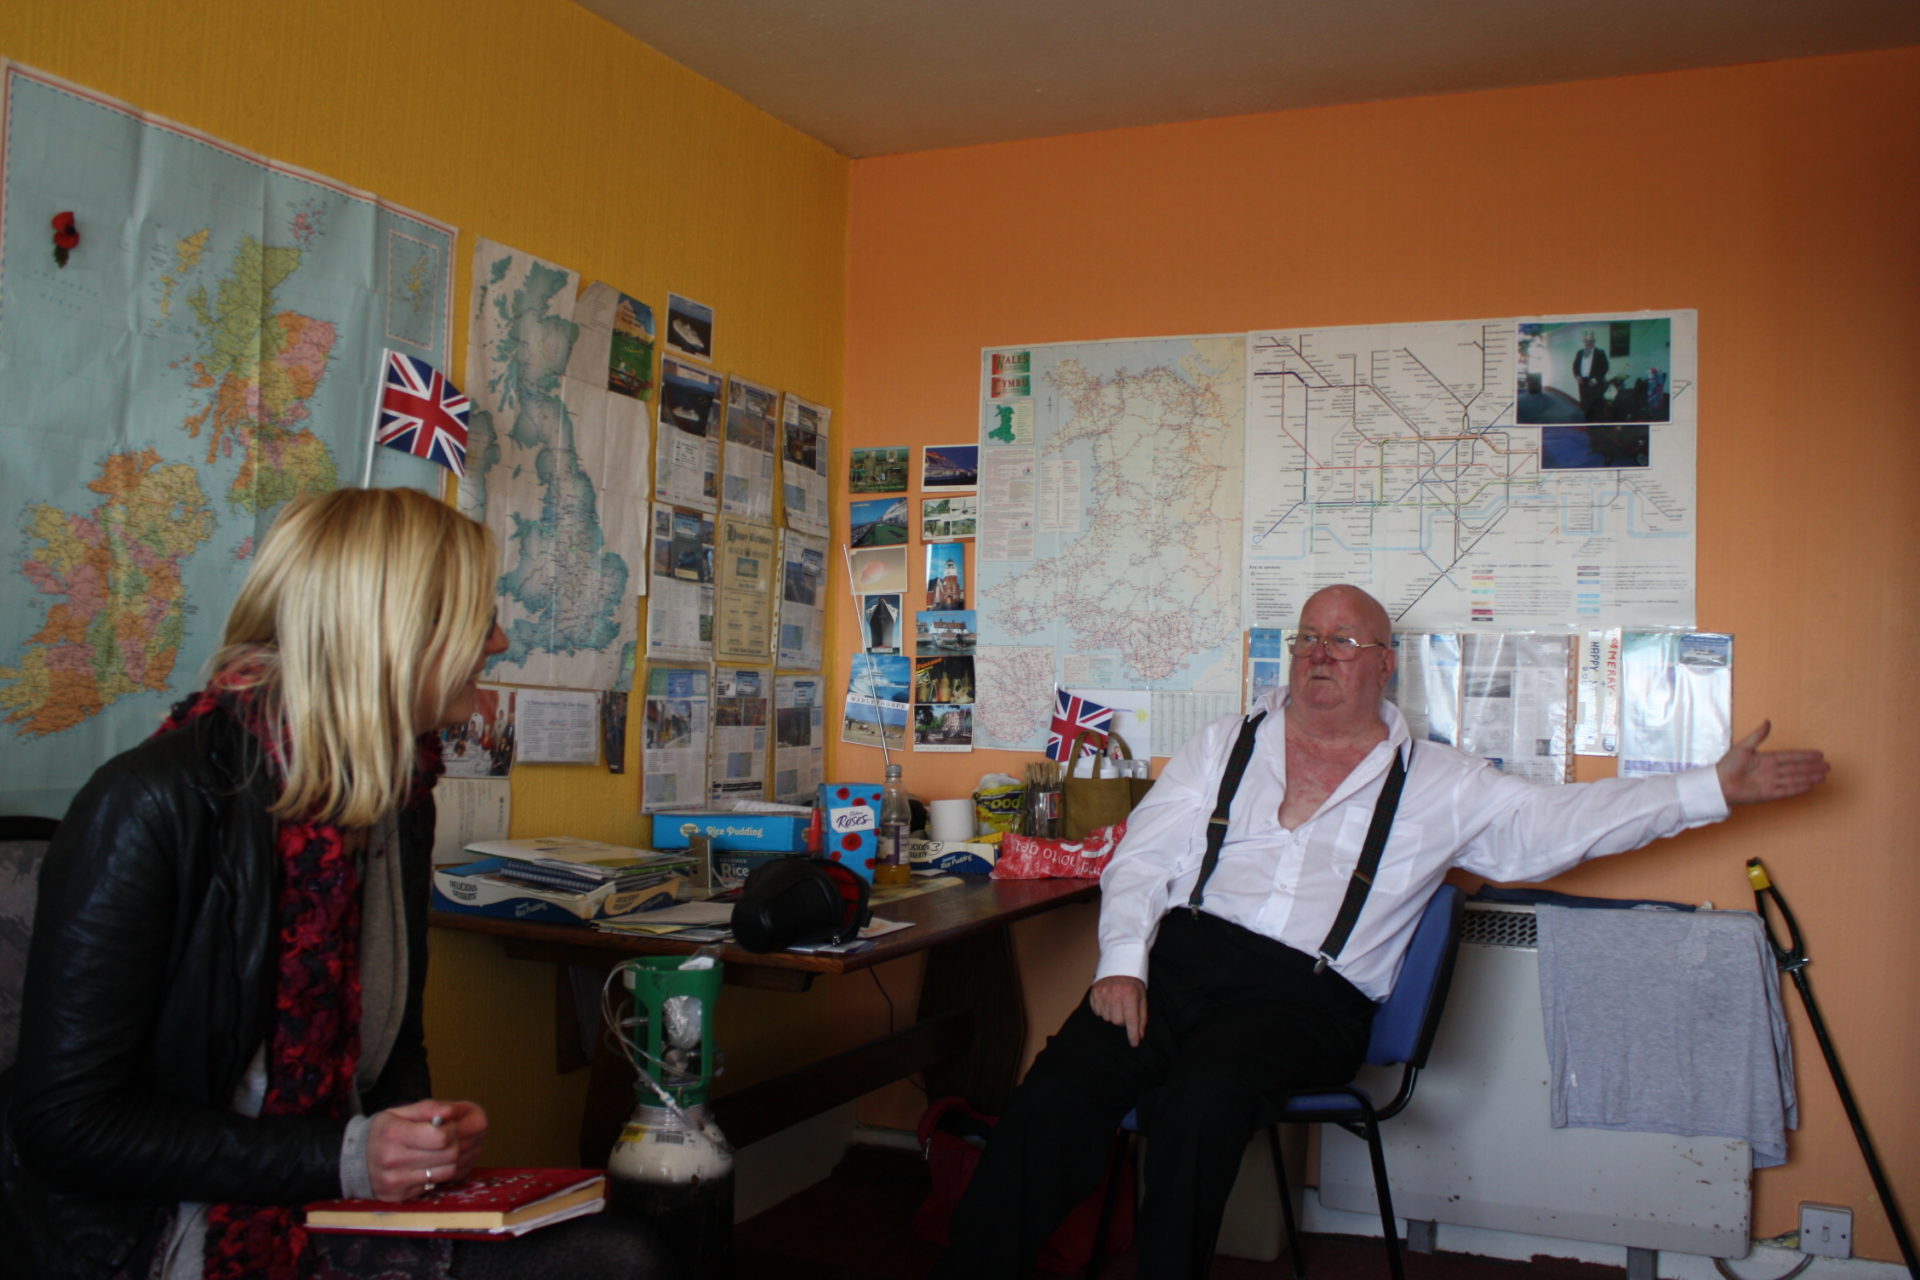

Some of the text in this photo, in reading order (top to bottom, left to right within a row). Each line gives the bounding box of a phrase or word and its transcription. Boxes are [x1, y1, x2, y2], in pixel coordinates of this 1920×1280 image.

[993, 354, 1029, 370] WALES
[993, 379, 1028, 395] CYMRU
[1589, 641, 1600, 672] HAPPY
[1606, 650, 1618, 692] MERRY
[836, 814, 872, 829] Roses
[706, 826, 725, 838] Rice
[726, 826, 764, 839] Pudding
[720, 863, 750, 878] Rice
